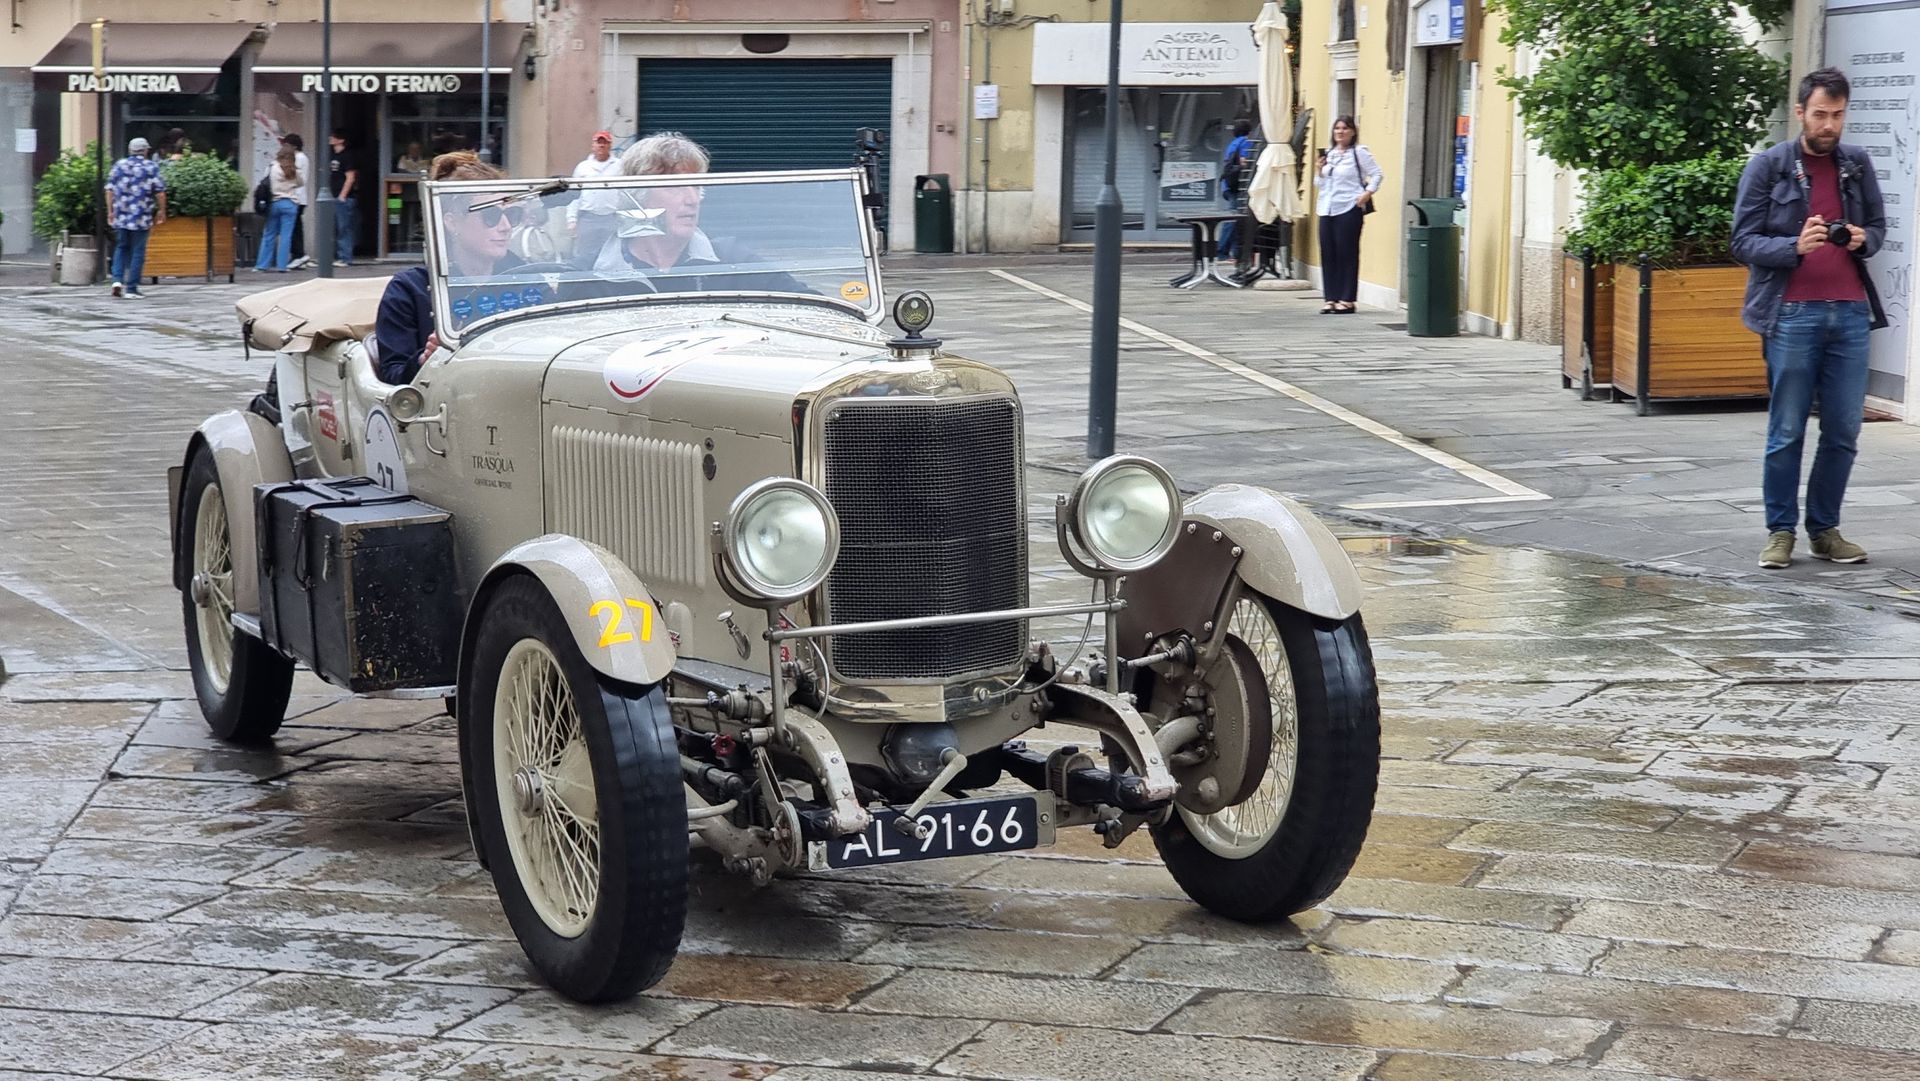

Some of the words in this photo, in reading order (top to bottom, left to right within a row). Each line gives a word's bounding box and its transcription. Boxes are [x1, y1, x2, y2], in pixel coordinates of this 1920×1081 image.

[1141, 46, 1239, 61] ANTEMIO
[68, 75, 181, 92] PIADINERIA
[486, 425, 498, 445] T
[472, 455, 515, 474] TRASQUA
[589, 598, 653, 648] 27
